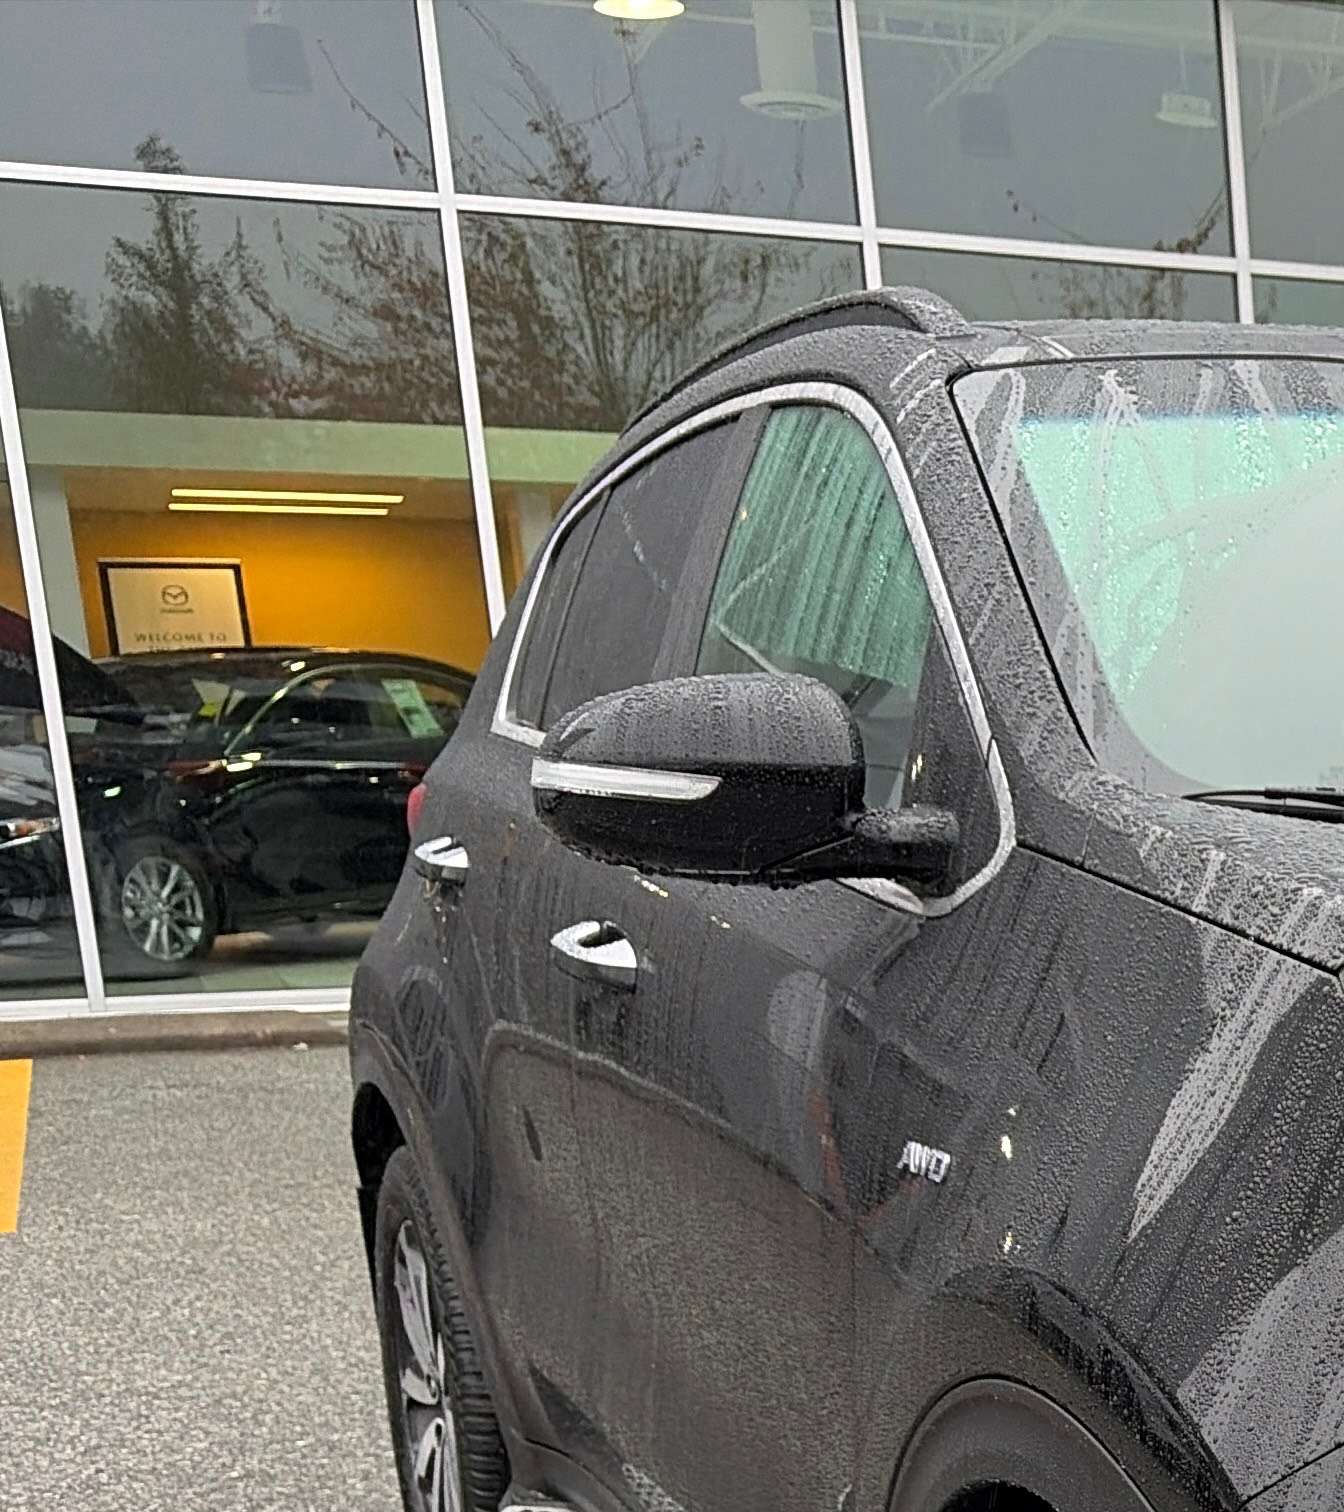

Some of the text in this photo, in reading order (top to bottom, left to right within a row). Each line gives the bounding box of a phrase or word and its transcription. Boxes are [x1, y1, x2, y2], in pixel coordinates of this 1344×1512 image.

[134, 631, 227, 643] WELCOME TO
[897, 1141, 951, 1183] AWD
